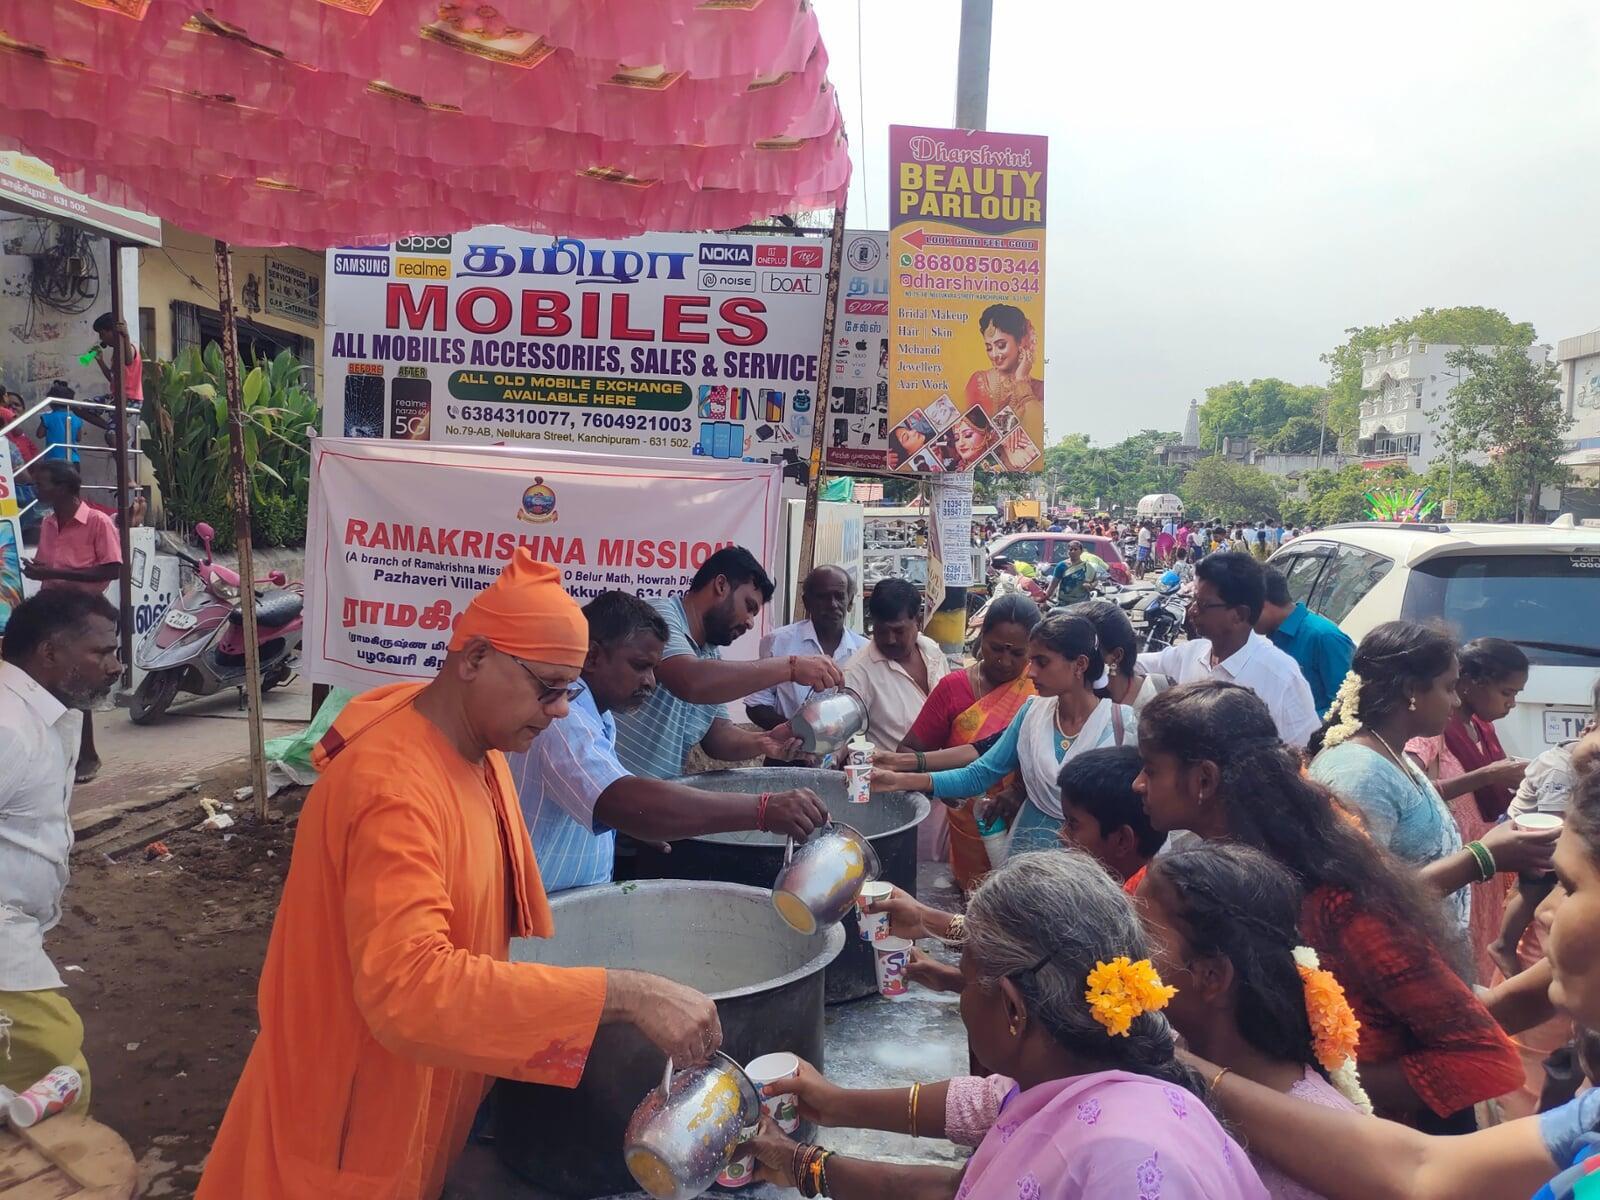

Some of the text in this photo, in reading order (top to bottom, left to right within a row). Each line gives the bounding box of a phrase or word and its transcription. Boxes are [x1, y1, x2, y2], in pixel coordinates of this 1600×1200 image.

[909, 135, 1033, 168] Dharshvini
[900, 162, 1042, 198] BEAUTY
[900, 190, 1042, 222] PARLOUR
[926, 235, 1034, 249] LOOK GOOD FEEL GOOD
[456, 239, 694, 284] தமிழா
[701, 247, 750, 261] NOKIA
[757, 257, 787, 265] ONEPLUS
[335, 257, 388, 274] SAMSUNG
[399, 261, 447, 277] realme
[914, 254, 1040, 275] 8680850344
[385, 282, 769, 347] MOBILES
[898, 308, 969, 323] Bridal Makeup
[898, 326, 953, 338] Hair Skin
[332, 332, 818, 382] ALL MOBILES ACCESSORIES, SALES & SERVICE
[348, 364, 384, 375] BEFORE
[398, 367, 426, 378] AFTER
[458, 373, 683, 394] ALL OLD MOBILE EXCHANGE
[922, 380, 950, 391] Work
[395, 400, 427, 409] realme
[503, 389, 637, 406] AVAILABLE HERE
[395, 416, 426, 435] 5G
[461, 405, 692, 433] 6384310077, 7604921003
[446, 425, 494, 438] No.79-AB,
[497, 428, 541, 440] Nellukara
[544, 431, 576, 443] Street,
[577, 433, 640, 446] Kanchipuram
[649, 436, 669, 447] 631
[345, 518, 586, 565] RAMAKRISHNA
[361, 553, 399, 567] branch
[402, 557, 412, 568] of
[414, 559, 475, 574] Ramakrishna
[575, 571, 603, 582] Belur
[606, 572, 634, 585] Math,
[637, 574, 676, 586] Howrah
[374, 569, 447, 587] Pazhaveri
